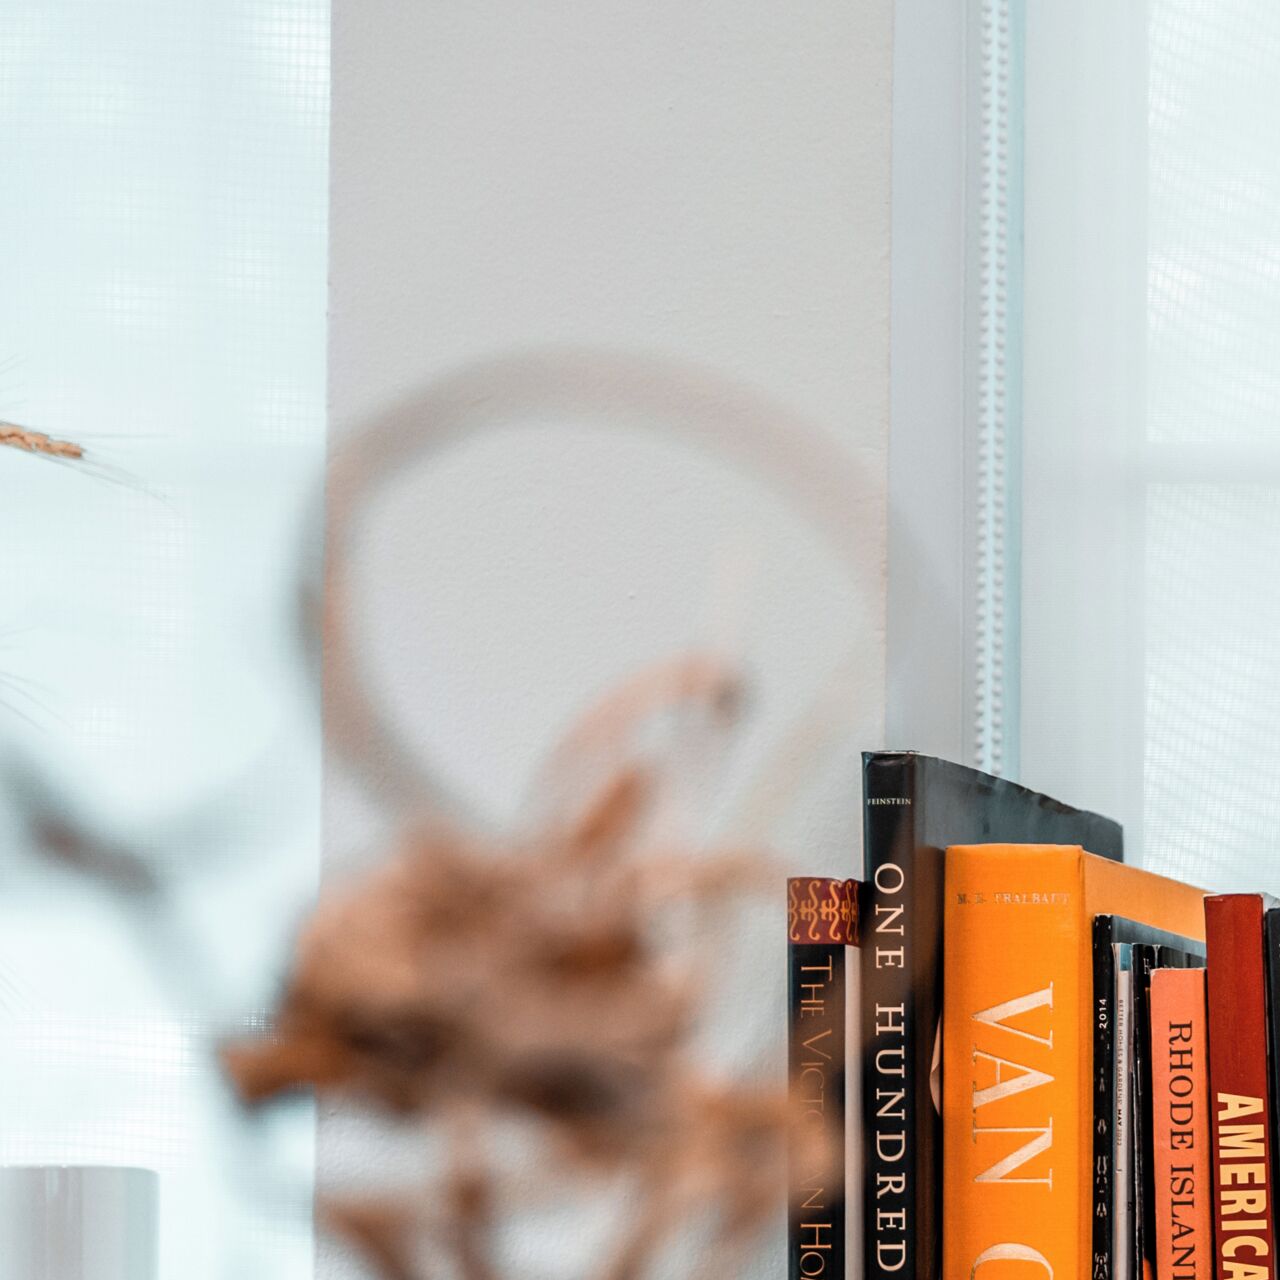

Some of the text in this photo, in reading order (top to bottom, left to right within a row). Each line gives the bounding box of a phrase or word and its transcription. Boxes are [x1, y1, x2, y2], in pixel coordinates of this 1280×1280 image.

[867, 797, 912, 806] FEINSTEIN
[874, 862, 906, 970] ONE
[800, 955, 833, 1016] THE
[1098, 998, 1108, 1029] 2014
[874, 1002, 907, 1273] HUNDRED
[970, 981, 1055, 1191] VAN
[1168, 1020, 1195, 1151] RHODE
